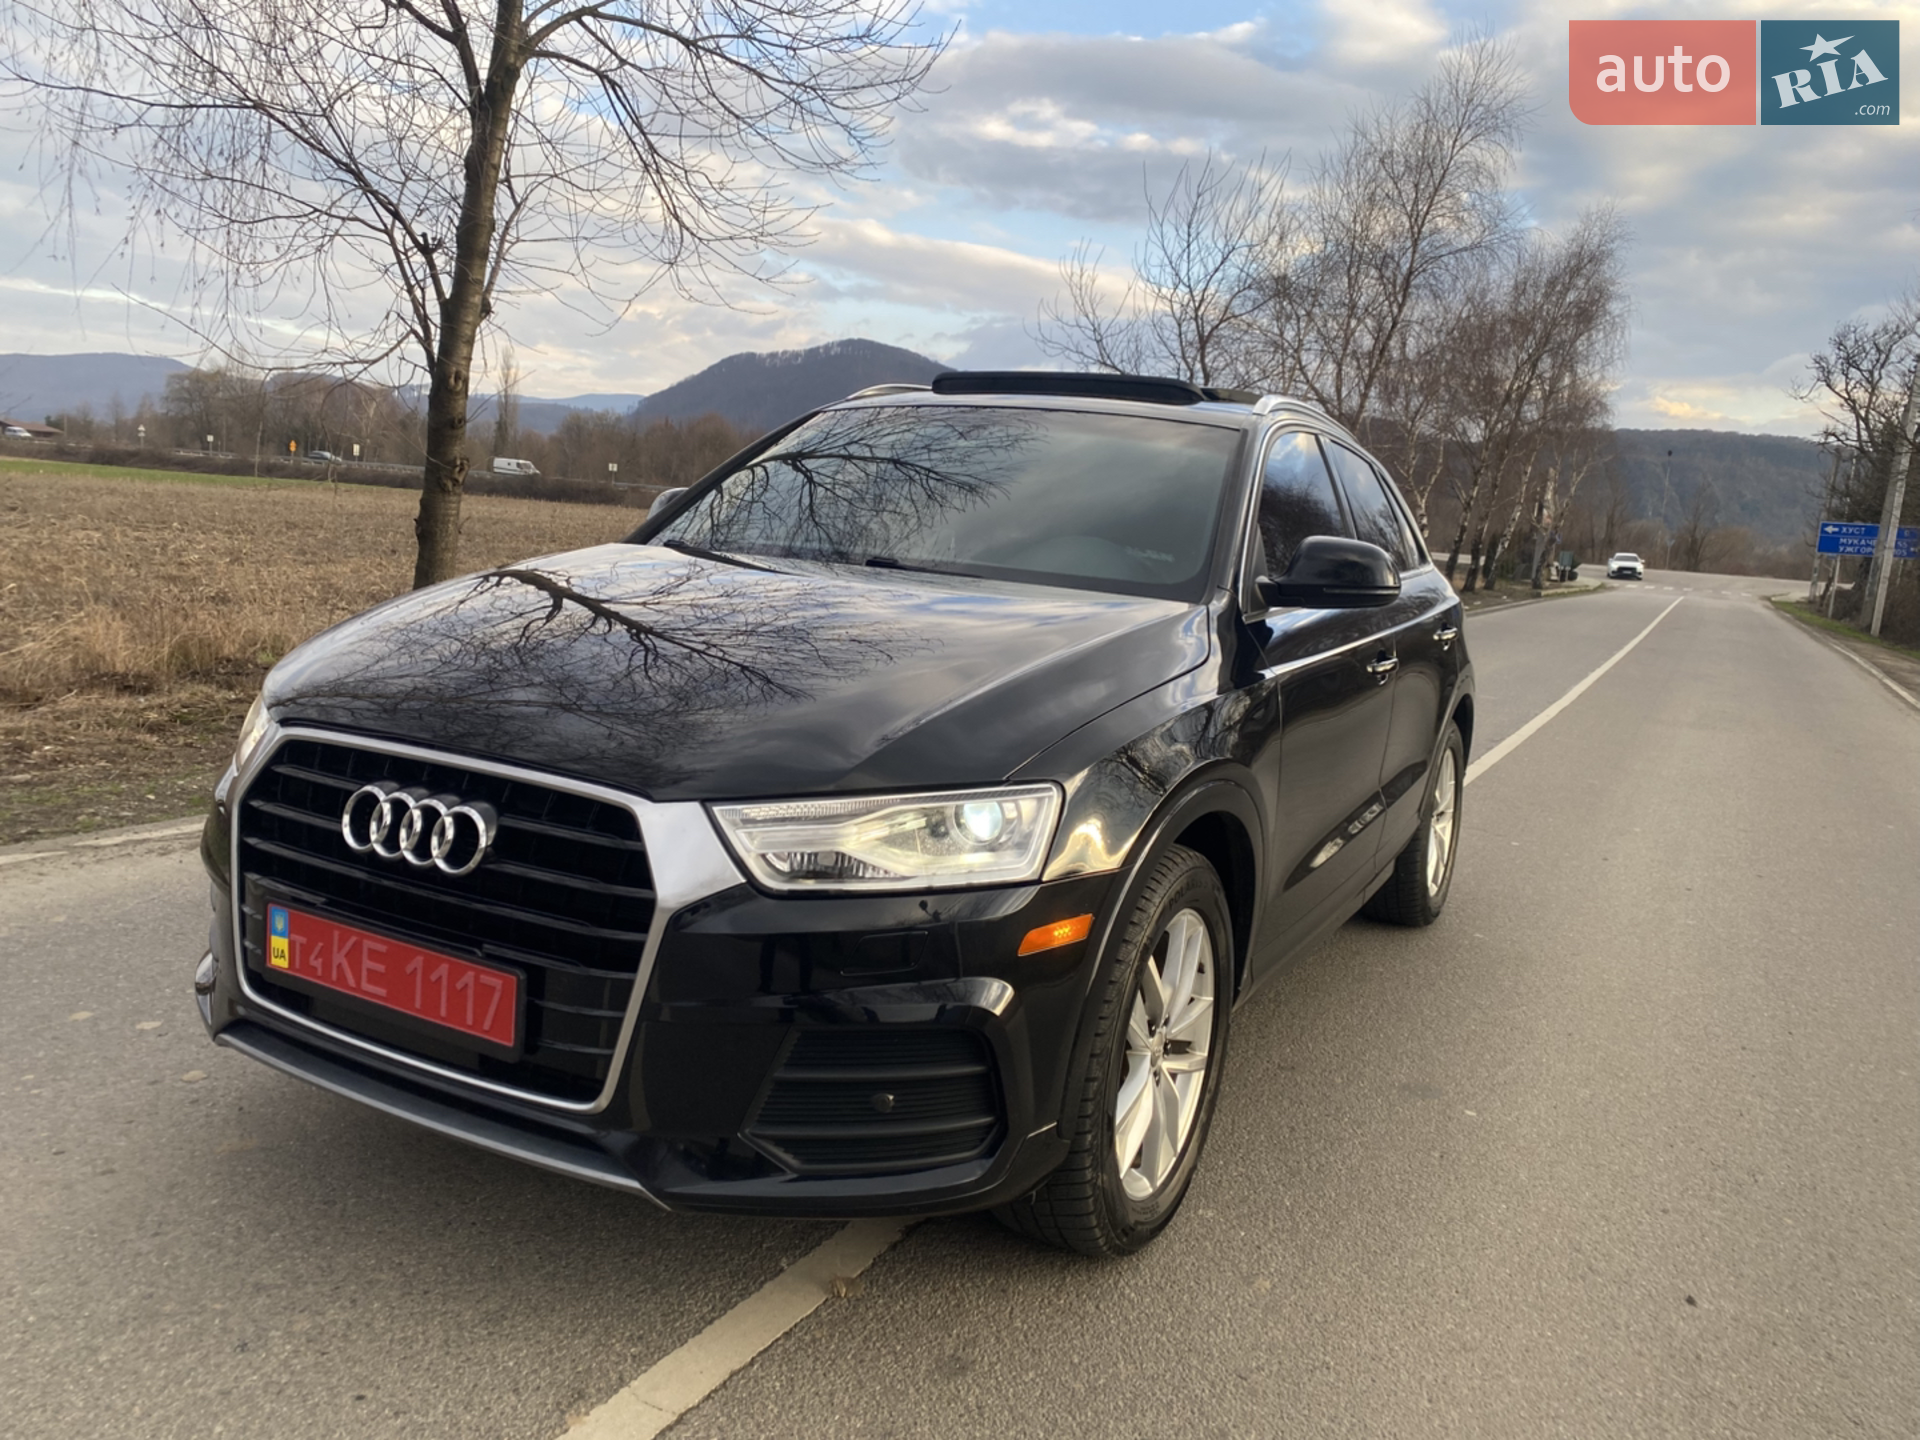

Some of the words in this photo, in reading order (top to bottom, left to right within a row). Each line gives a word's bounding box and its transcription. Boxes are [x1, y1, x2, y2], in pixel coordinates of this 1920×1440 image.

[1840, 526, 1866, 535] ХУСТ
[271, 947, 287, 961] UA
[405, 955, 503, 1031] 1117
